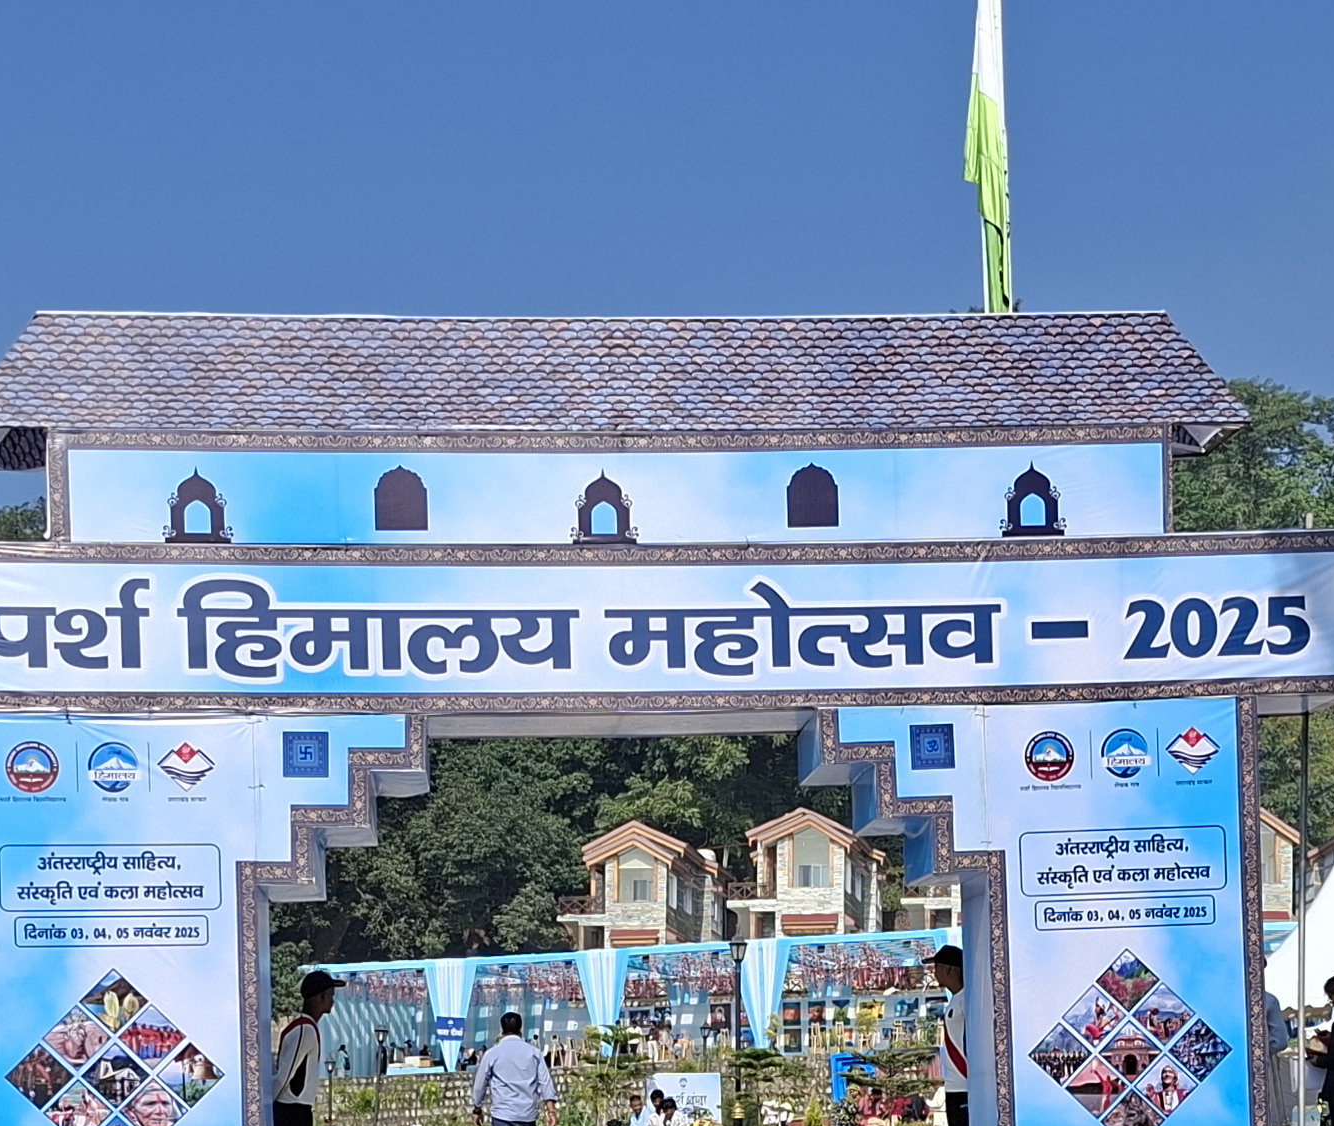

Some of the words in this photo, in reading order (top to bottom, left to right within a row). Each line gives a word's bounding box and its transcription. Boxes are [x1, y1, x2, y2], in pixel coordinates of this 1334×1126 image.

[177, 579, 580, 678] हिमालय
[604, 581, 1002, 676] महोत्सव
[1123, 595, 1312, 660] 2025
[1107, 757, 1146, 767] हिमालय
[94, 770, 136, 780] हिमालय
[1055, 836, 1130, 859] अंतरराष्ट्रीय
[1134, 834, 1189, 853] साहित्य,
[37, 851, 118, 875] अंतरराष्ट्रीय
[122, 851, 181, 871] साहित्य,
[1036, 865, 1088, 889] संस्कृति
[1093, 865, 1115, 883] एवं
[1117, 868, 1149, 882] कला
[1153, 862, 1210, 881] महोत्सव
[17, 881, 73, 905] संस्कृति
[78, 881, 101, 899] एवं
[104, 886, 139, 900] कला
[143, 881, 204, 900] महोत्सव
[1043, 907, 1084, 923] दिनांक
[1087, 911, 1104, 922] 03,
[1108, 910, 1125, 921] 04,
[1129, 909, 1141, 920] 05
[1183, 906, 1207, 918] 2025
[24, 923, 68, 940] दिनांक
[71, 927, 89, 940] 03,
[93, 927, 111, 940] 04,
[116, 927, 129, 939] 05
[174, 926, 200, 939] 2025
